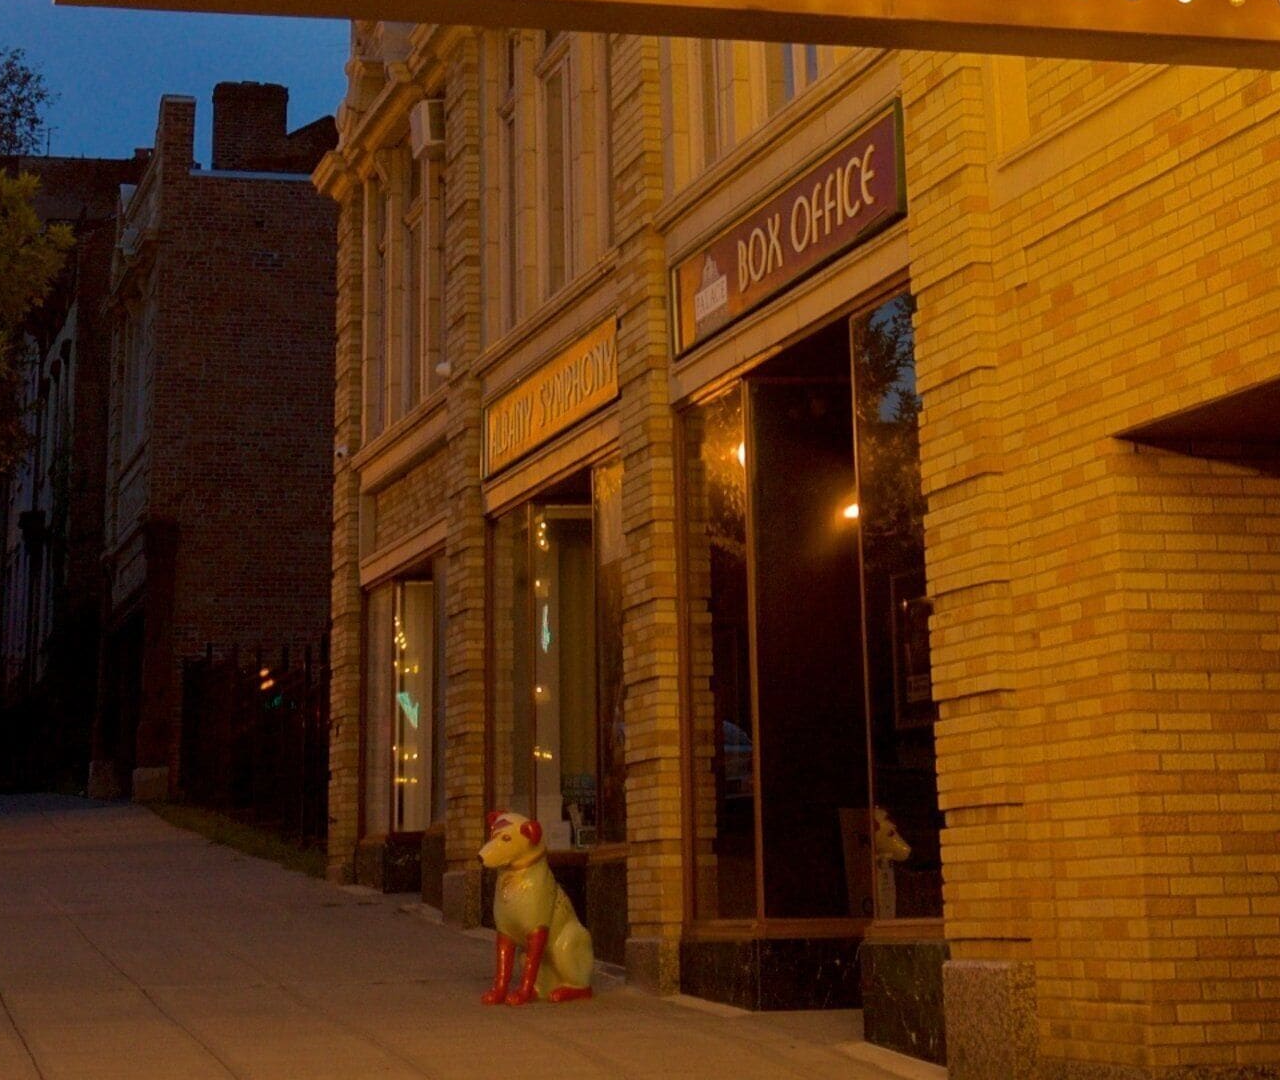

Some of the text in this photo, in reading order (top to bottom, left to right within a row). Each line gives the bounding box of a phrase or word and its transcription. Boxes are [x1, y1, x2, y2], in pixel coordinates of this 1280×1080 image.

[737, 144, 875, 294] BOX OFFICE
[491, 335, 617, 456] ALBANY SYMPHONY
